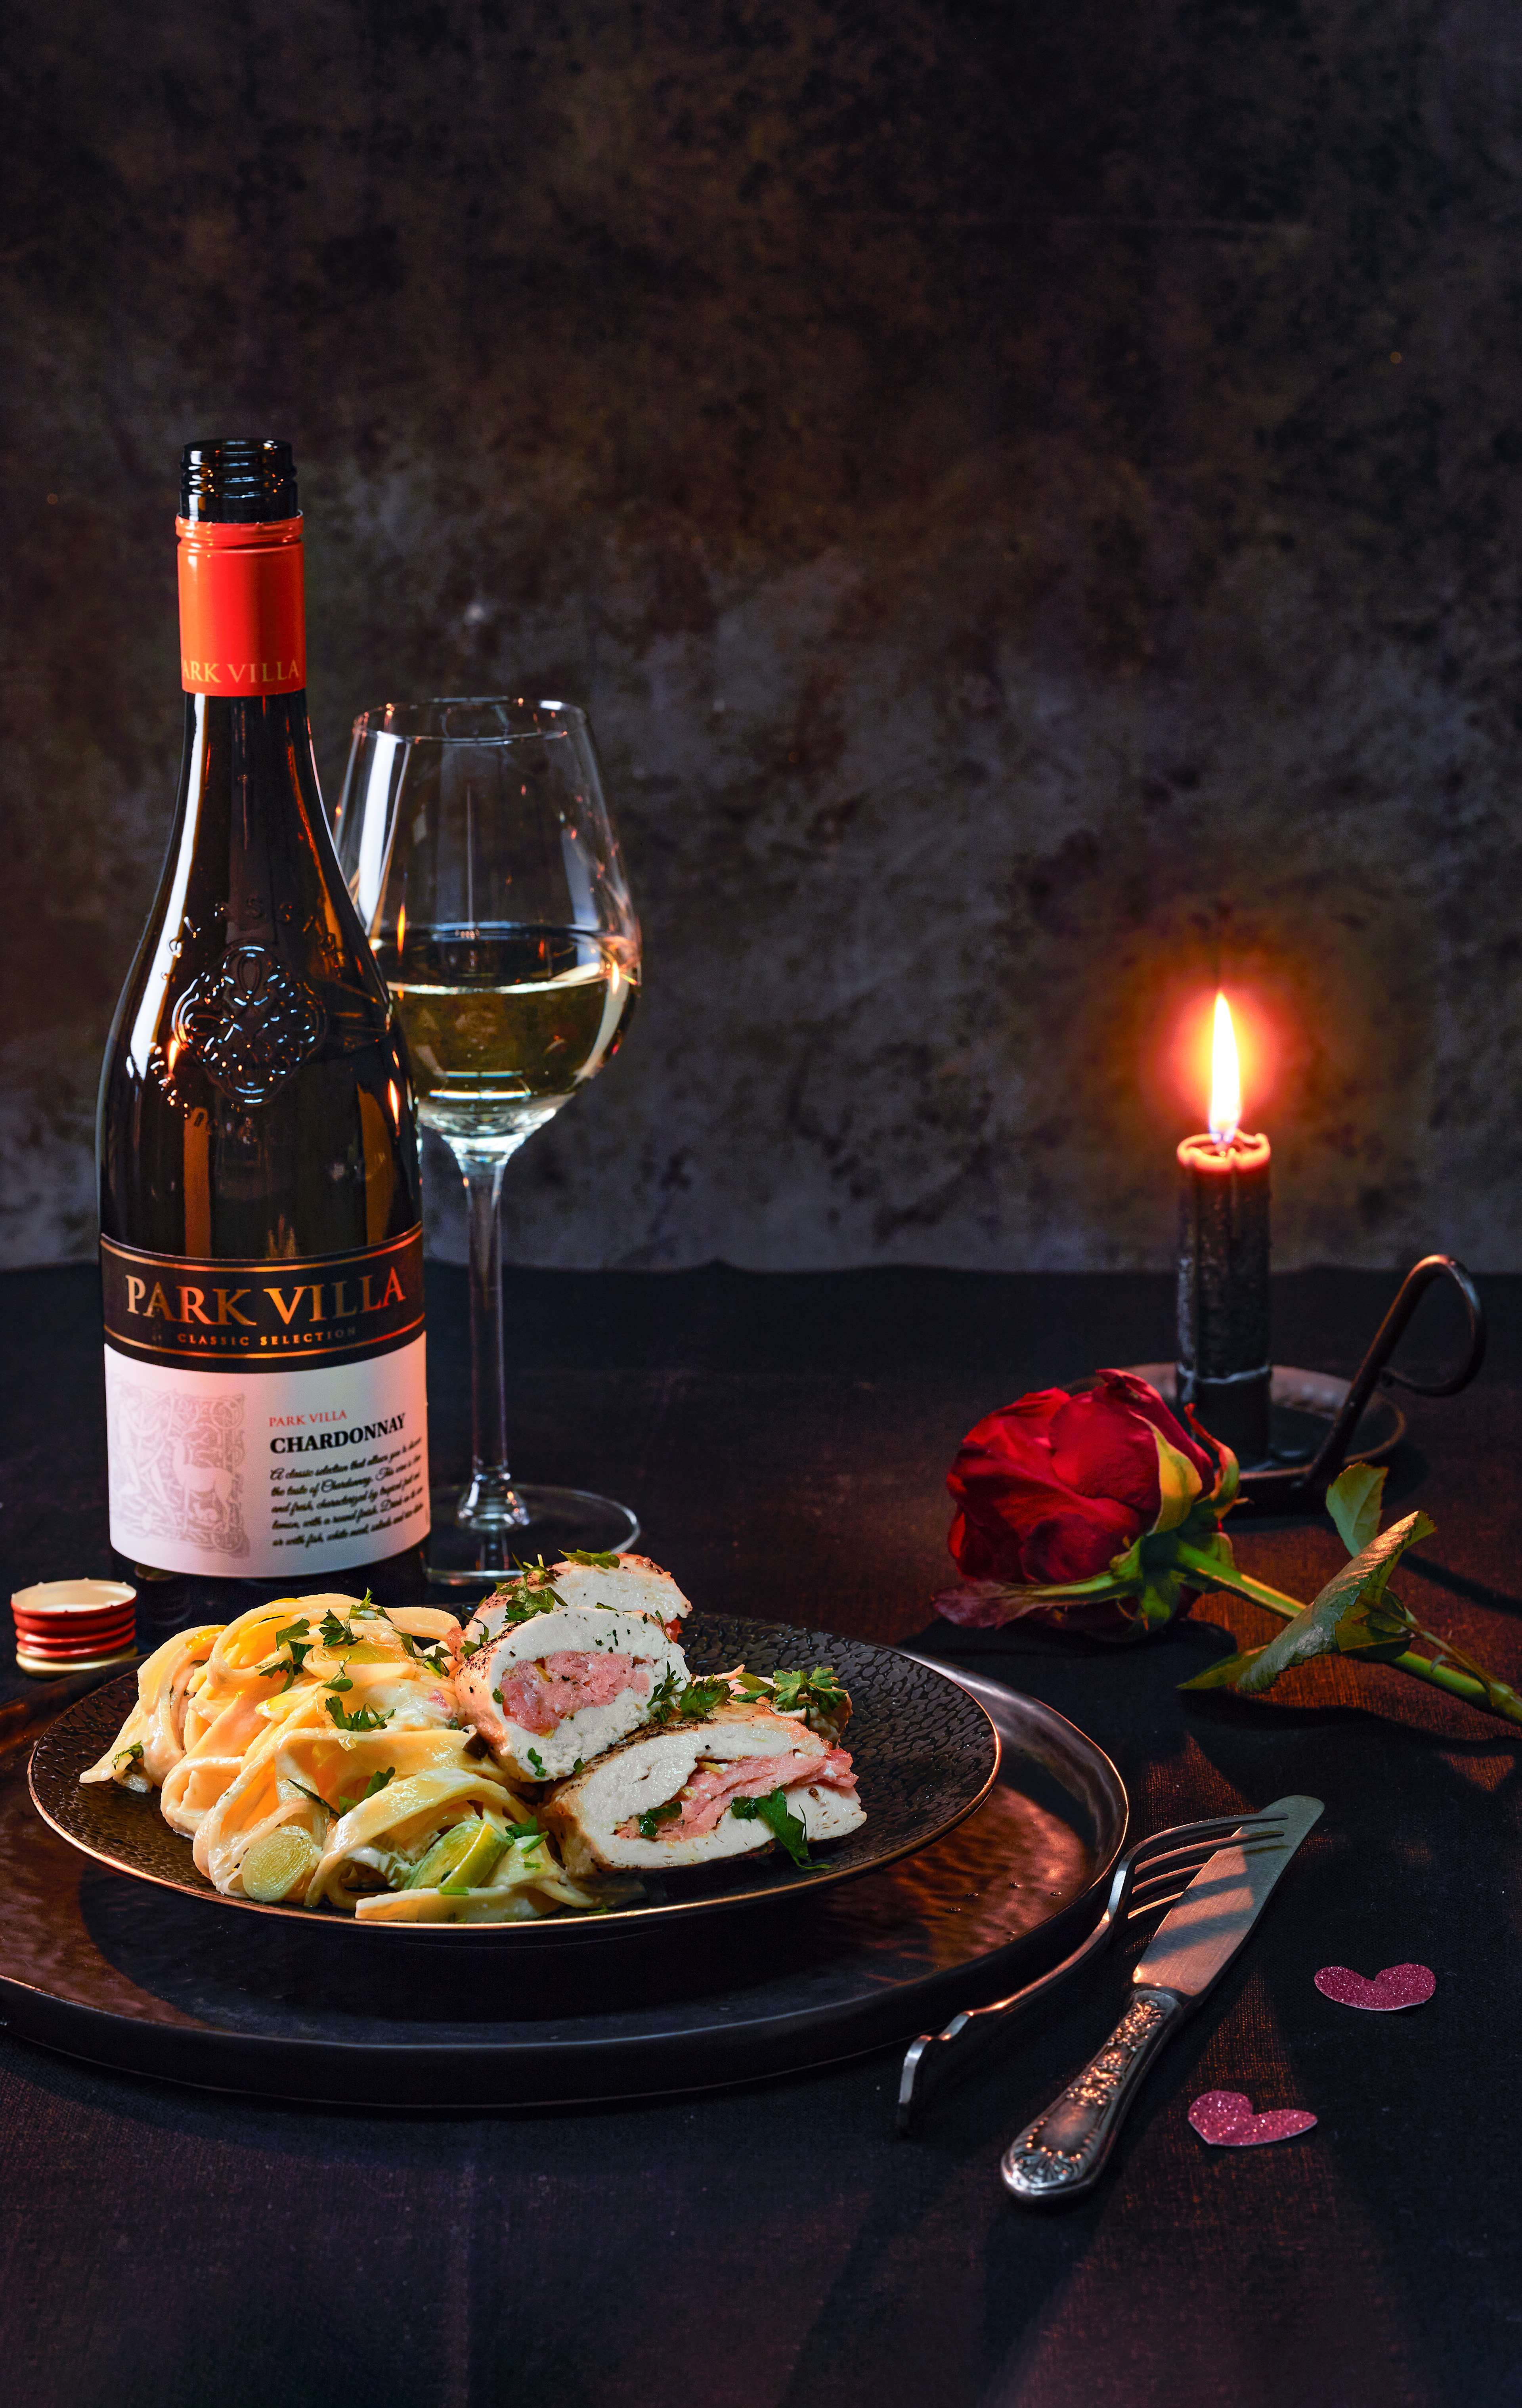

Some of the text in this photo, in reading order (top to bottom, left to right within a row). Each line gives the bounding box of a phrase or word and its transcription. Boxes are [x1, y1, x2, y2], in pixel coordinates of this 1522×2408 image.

[182, 659, 299, 683] ARK VILLA
[124, 1266, 407, 1326] PARK VILLA
[177, 1326, 356, 1346] CLASSIC SELECTION
[269, 1410, 347, 1427] PARK VILLA
[270, 1413, 405, 1454] CHARDONNAY
[270, 1467, 285, 1480] A
[285, 1469, 314, 1479] classic
[315, 1463, 348, 1477] selection
[350, 1458, 366, 1470] that
[367, 1455, 388, 1465] allows
[388, 1451, 400, 1463] you
[271, 1486, 285, 1496] the
[287, 1485, 308, 1495] taste
[309, 1482, 319, 1498] of
[375, 1467, 394, 1481] This
[271, 1502, 289, 1513] and
[289, 1501, 314, 1516] fresh,
[368, 1489, 378, 1502] by
[379, 1479, 402, 1497] tropical
[401, 1475, 413, 1492] fruit
[302, 1516, 321, 1527] with
[333, 1509, 358, 1524] round
[380, 1499, 402, 1513] Drink
[285, 1534, 304, 1545] with
[305, 1532, 323, 1548] fish,
[327, 1529, 348, 1541] white
[371, 1518, 392, 1532] salads
